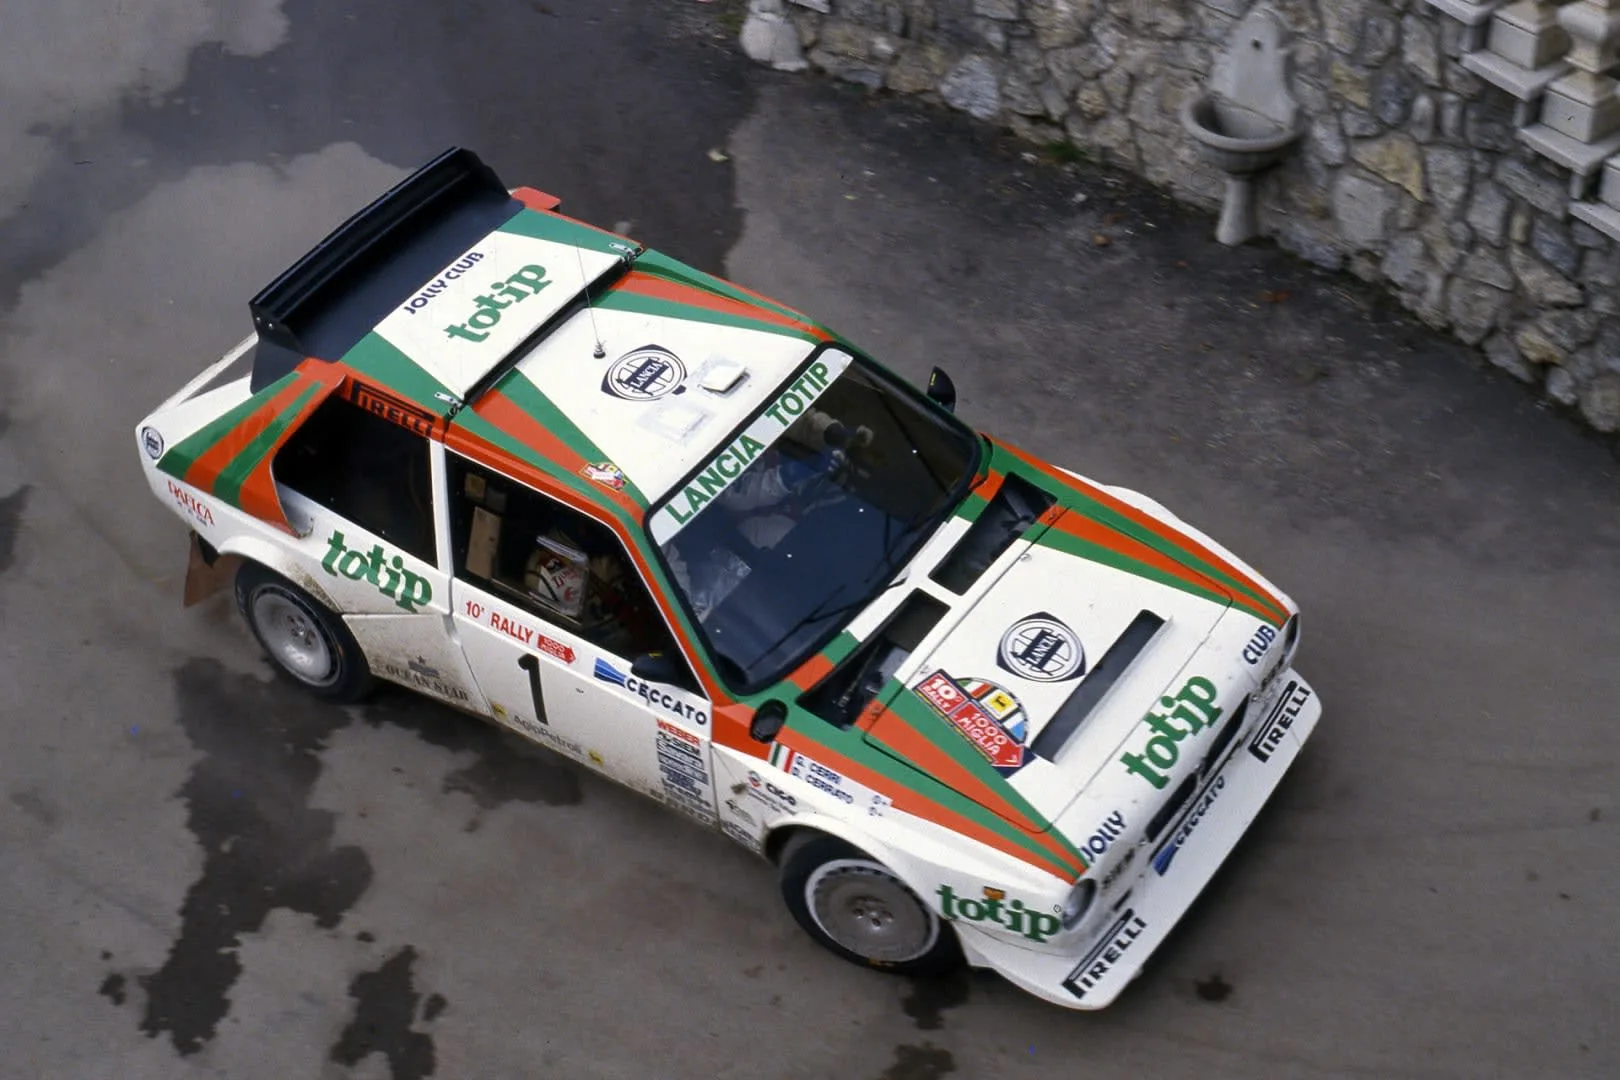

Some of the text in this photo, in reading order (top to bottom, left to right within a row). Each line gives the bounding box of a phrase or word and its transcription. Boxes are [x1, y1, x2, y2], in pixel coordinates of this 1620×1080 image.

[403, 251, 484, 314] JOLLY CLUB
[443, 263, 553, 344] totip
[630, 361, 666, 389] LANCIA
[352, 380, 434, 437] PIRELLI
[664, 361, 830, 526] LANCIA TOTIP
[321, 529, 433, 614] totip
[490, 611, 534, 645] RALLY
[1241, 624, 1276, 665] CLUB
[517, 653, 549, 726] 1
[626, 677, 708, 726] CECCATO
[922, 685, 952, 709] RALLY
[656, 718, 701, 746] WEBER
[958, 717, 1001, 756] MIGLIA
[970, 712, 1008, 745] 1000
[1119, 675, 1224, 790] totip
[1247, 680, 1311, 764] PIRELLI
[1081, 810, 1128, 862] JOLLY
[1174, 774, 1226, 848] CECCATO
[936, 884, 1063, 944] totip
[1061, 907, 1148, 1000] PIRELLI
